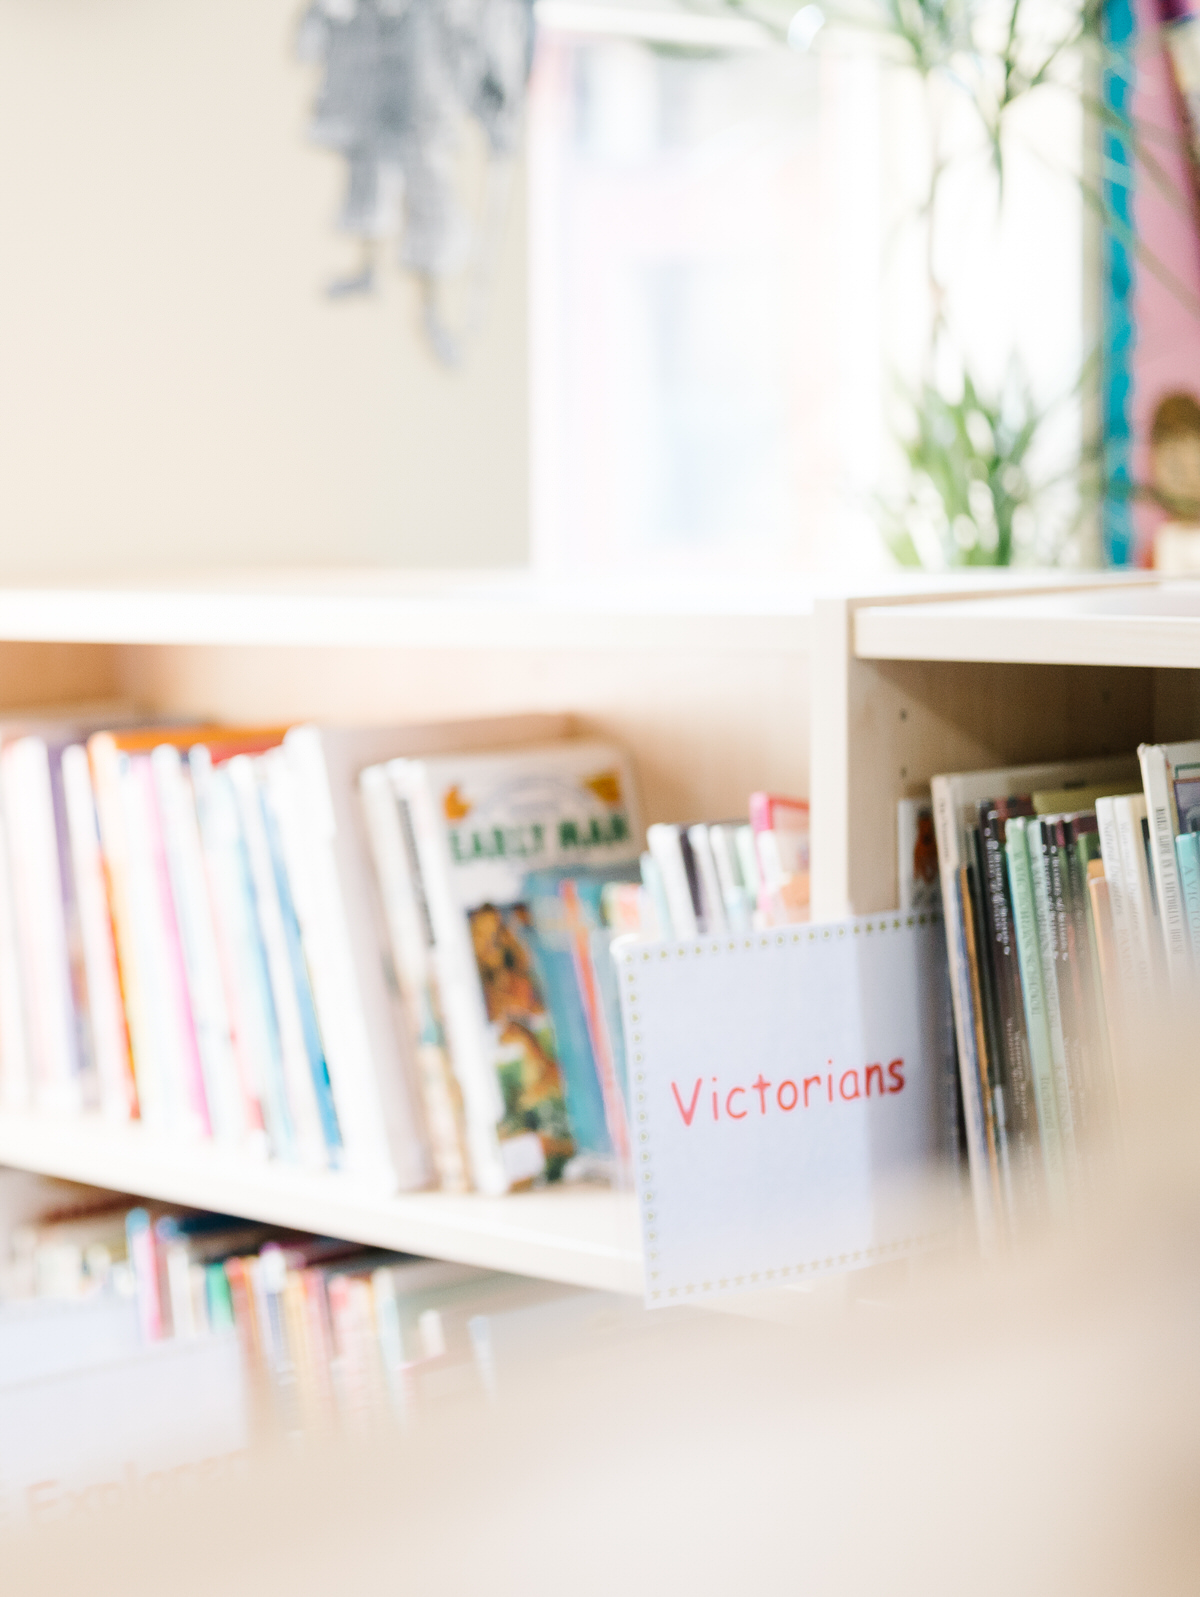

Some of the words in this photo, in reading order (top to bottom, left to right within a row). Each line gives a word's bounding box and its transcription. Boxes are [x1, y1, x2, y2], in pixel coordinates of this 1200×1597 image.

[449, 822, 544, 864] EARLY
[557, 814, 629, 850] MAN
[1165, 881, 1180, 924] VICTORIAN
[671, 1057, 905, 1127] Victorians
